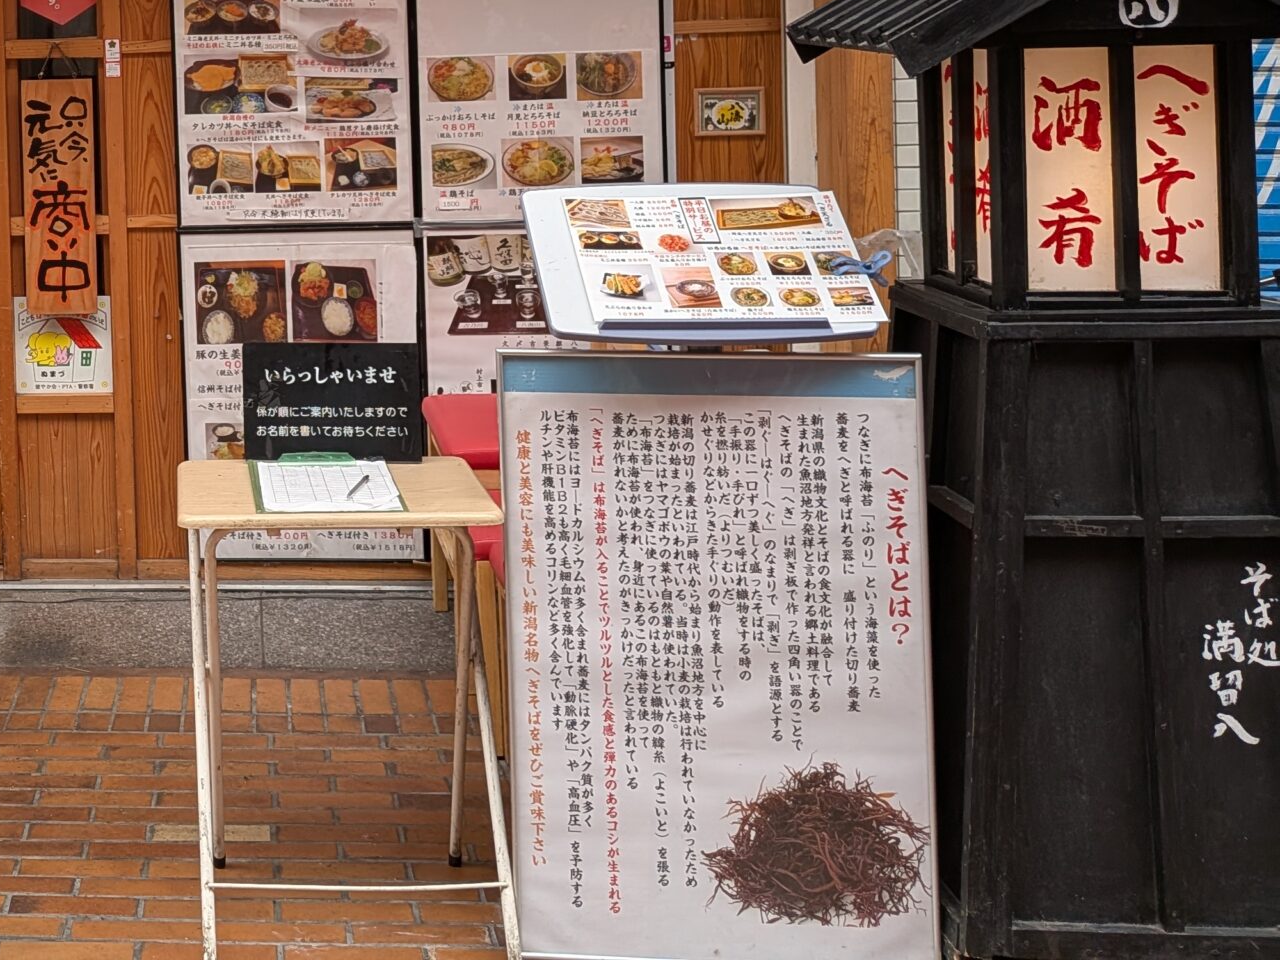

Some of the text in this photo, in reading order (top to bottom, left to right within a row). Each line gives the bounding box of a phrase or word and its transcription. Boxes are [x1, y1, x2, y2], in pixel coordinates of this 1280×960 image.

[24, 99, 68, 182] 元気に
[442, 123, 475, 131] 980円
[507, 112, 560, 121] 月見とろろそば
[587, 118, 628, 126] 1200円
[1031, 76, 1102, 268] 酒肴
[1136, 64, 1211, 264] へぎそば
[29, 180, 90, 303] 商い中
[257, 407, 408, 418] 係が順にご案内いたしますので
[264, 367, 397, 384] いらっしゃいませ
[257, 426, 408, 437] お名前を書いてお待ちください
[881, 467, 912, 645] へぎそばとは?
[1241, 562, 1280, 667] そば処
[1202, 620, 1260, 745] 満留八
